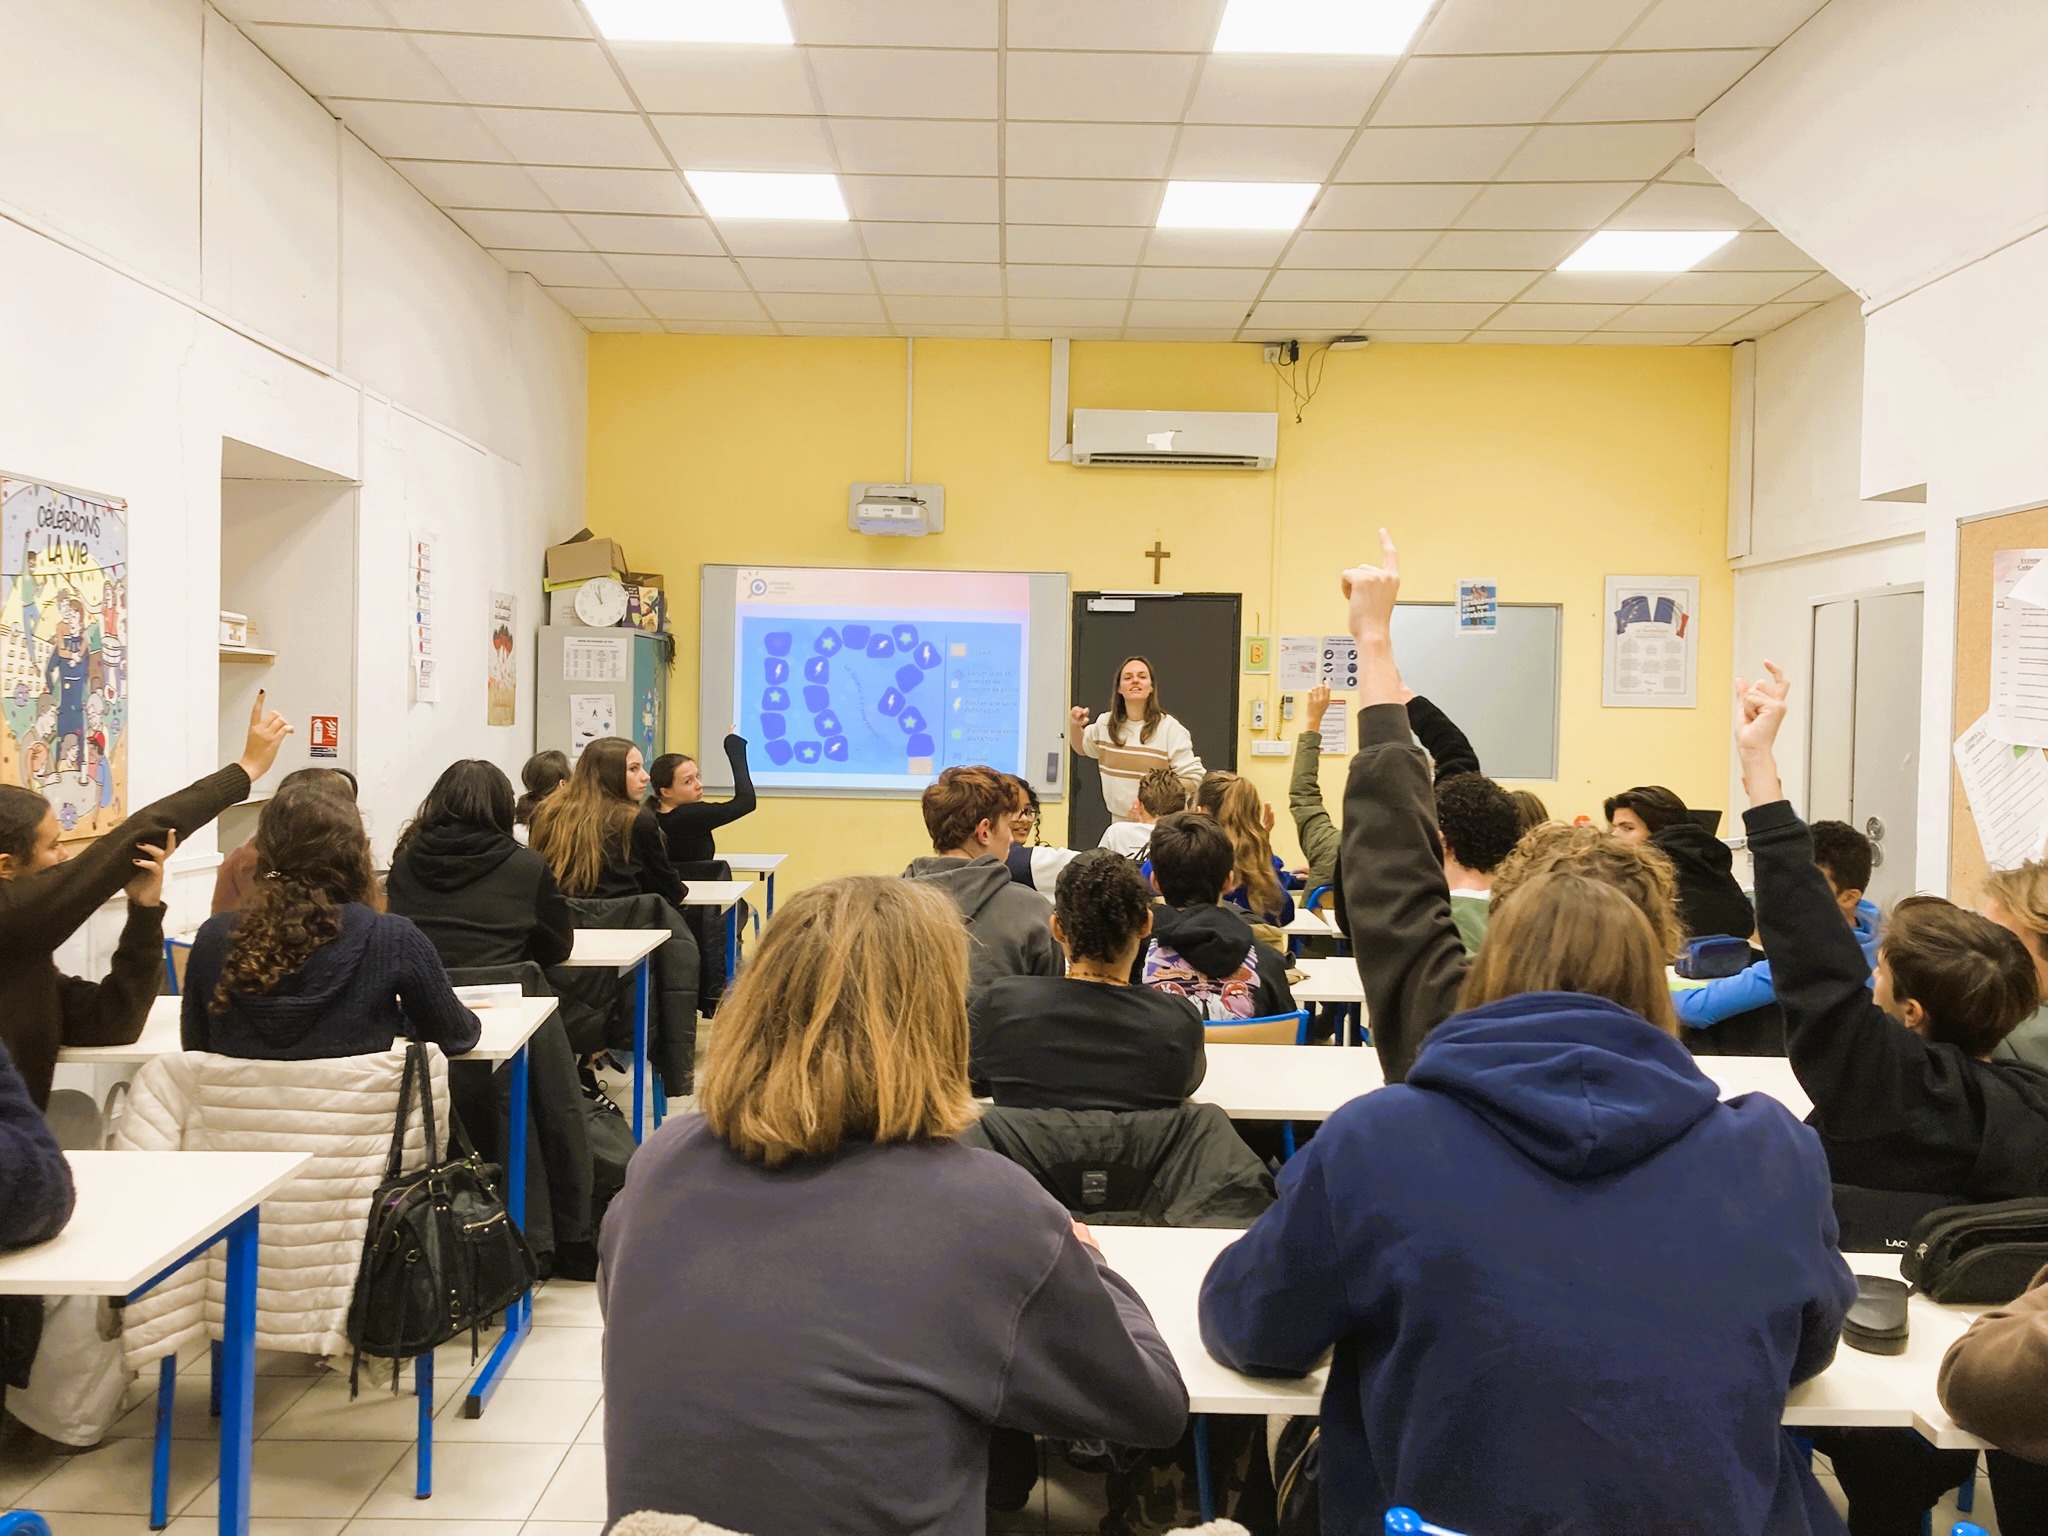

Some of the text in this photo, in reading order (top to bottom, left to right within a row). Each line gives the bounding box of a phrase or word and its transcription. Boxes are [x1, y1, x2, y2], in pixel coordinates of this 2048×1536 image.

[47, 534, 63, 565] LA
[1250, 643, 1264, 664] B
[1885, 1238, 1908, 1248] LAC
